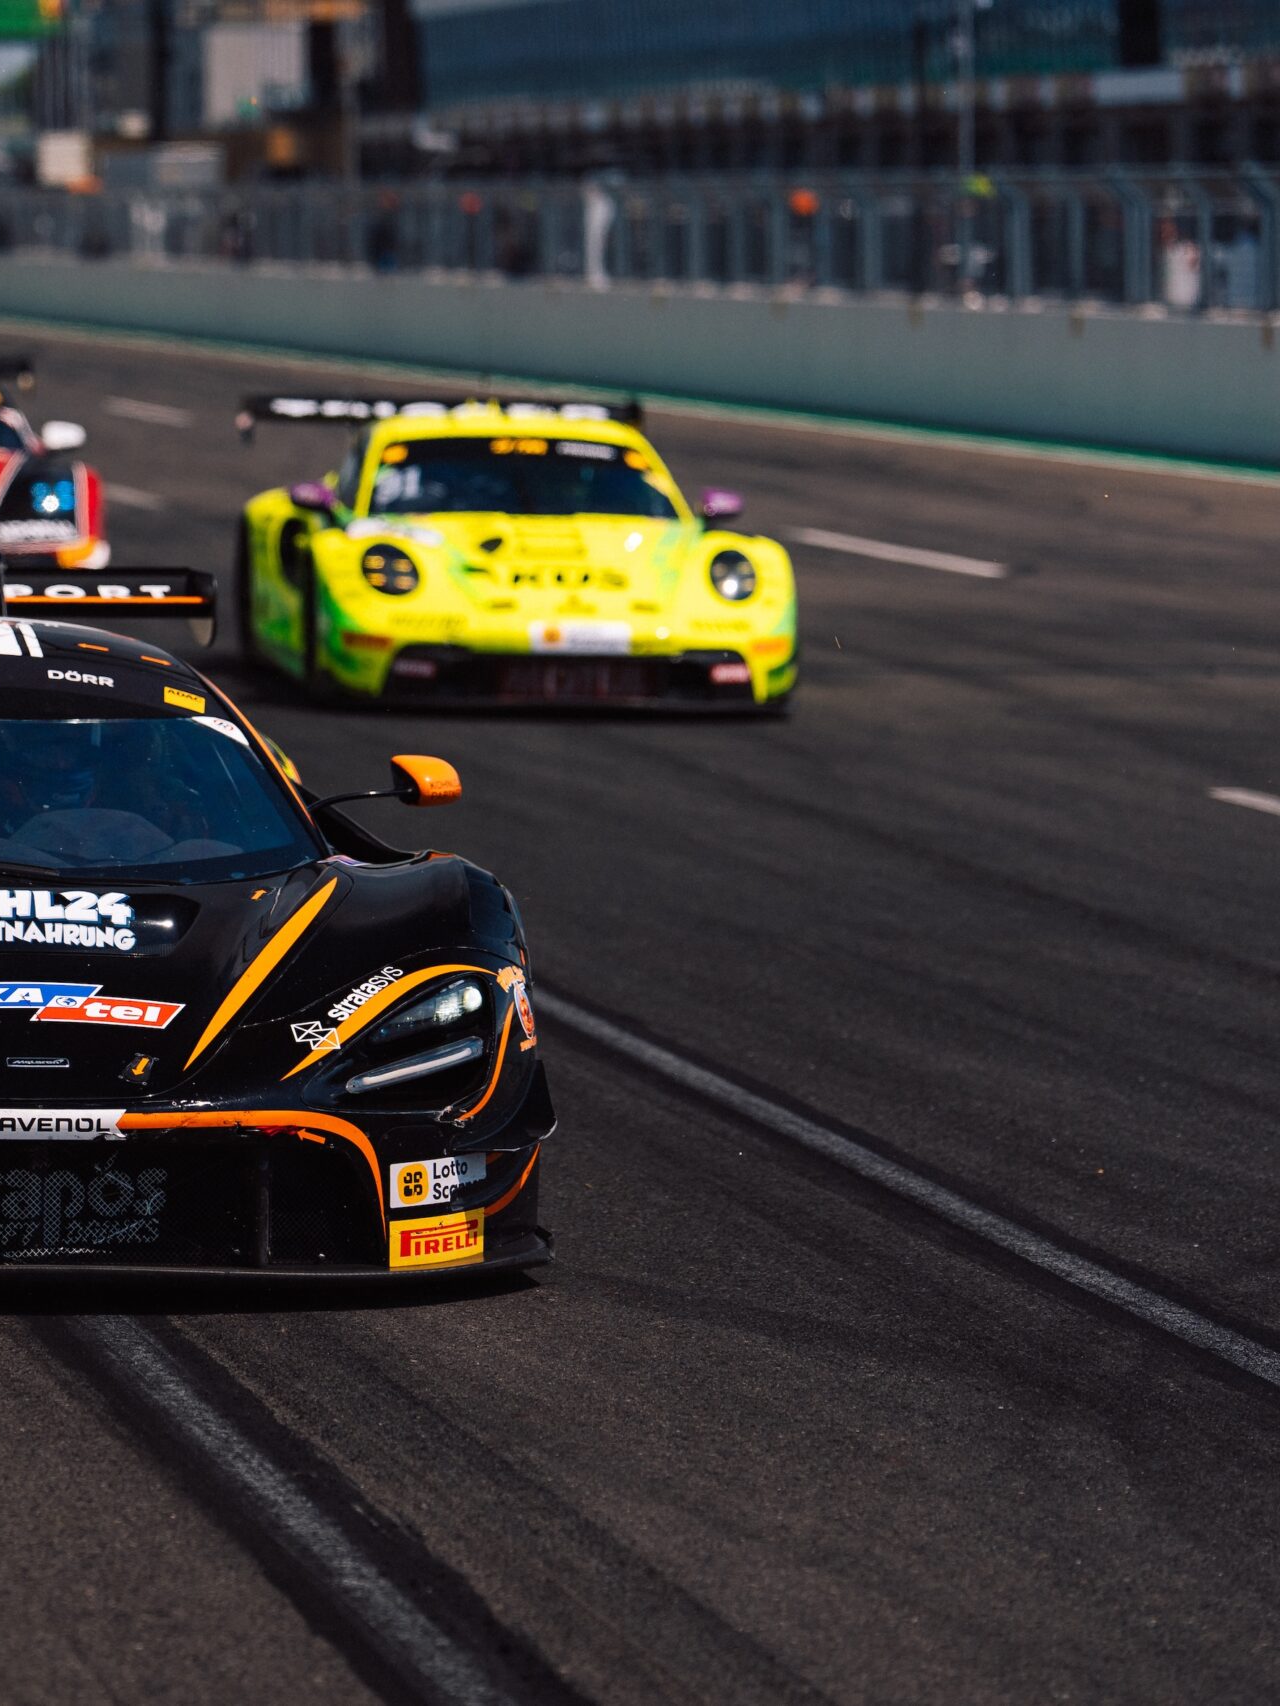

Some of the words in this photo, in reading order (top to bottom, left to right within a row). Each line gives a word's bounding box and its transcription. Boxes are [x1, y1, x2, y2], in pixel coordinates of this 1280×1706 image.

[47, 669, 115, 688] DÖRR
[327, 966, 403, 1021] stratasys
[83, 1000, 162, 1023] tel
[433, 1160, 468, 1180] Lotto
[400, 1219, 479, 1258] PIRELLI
